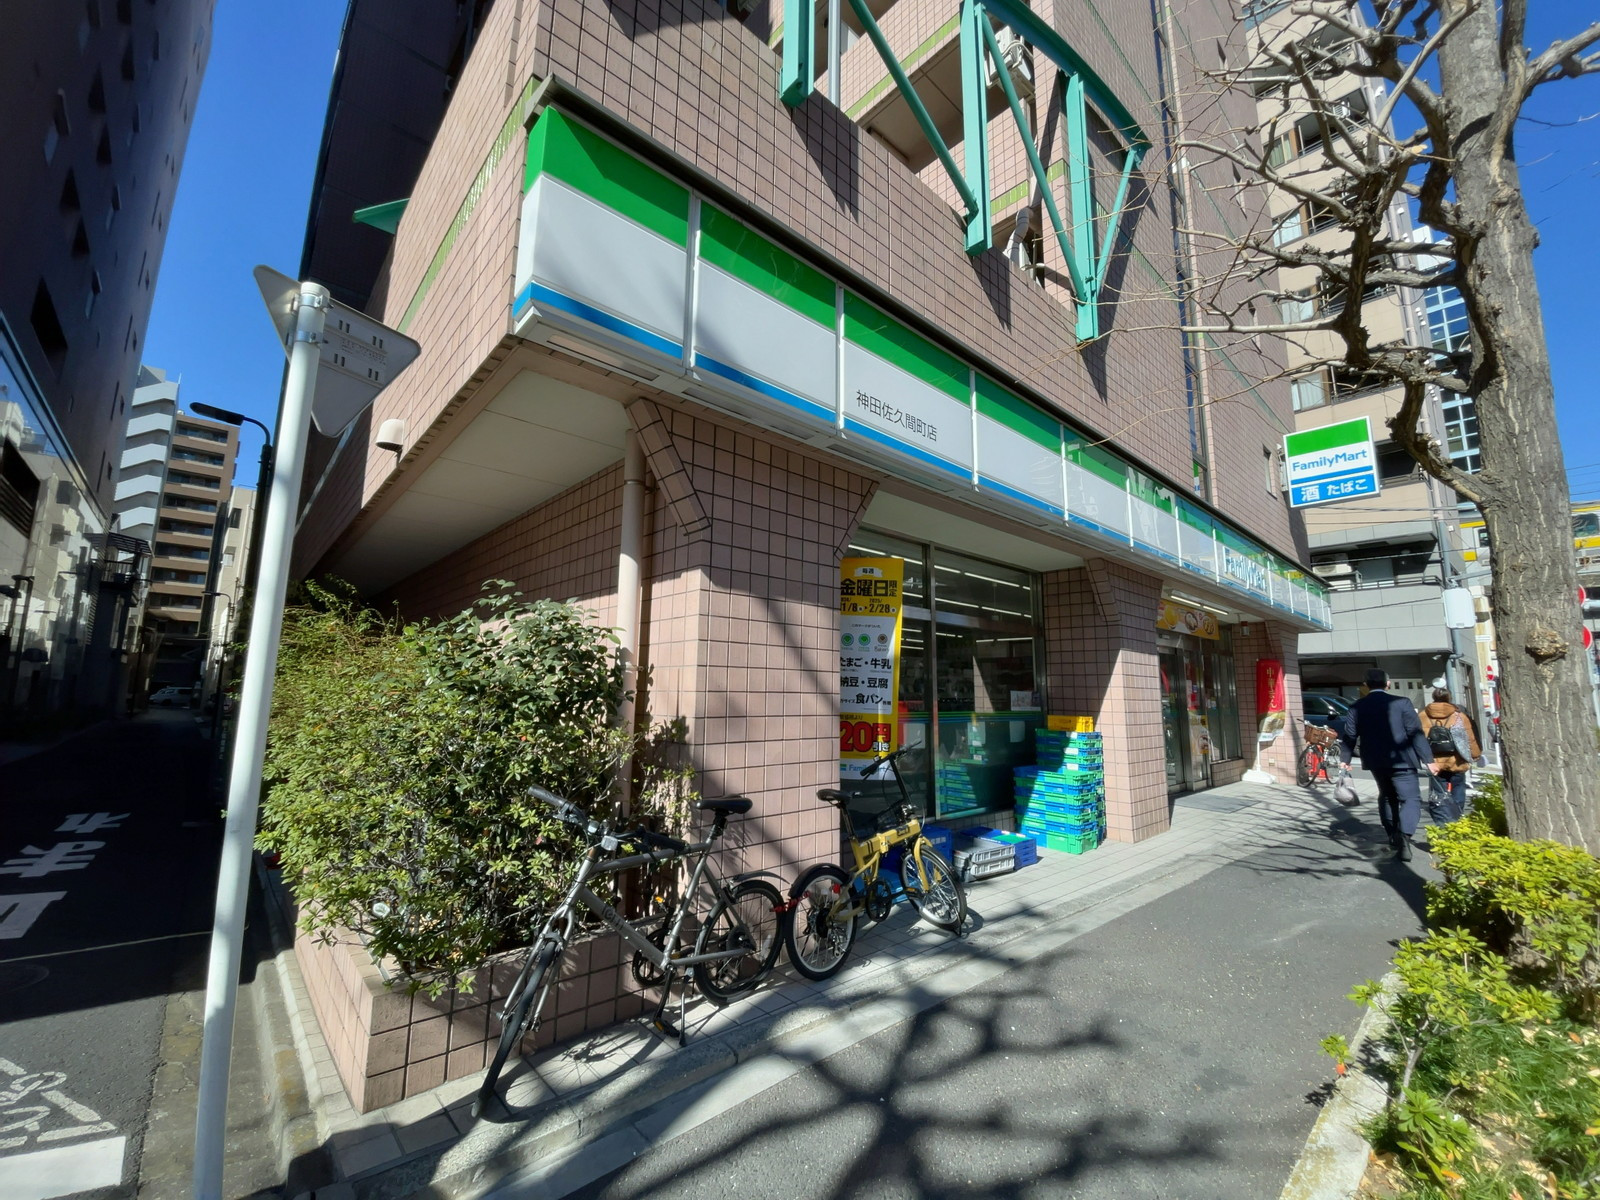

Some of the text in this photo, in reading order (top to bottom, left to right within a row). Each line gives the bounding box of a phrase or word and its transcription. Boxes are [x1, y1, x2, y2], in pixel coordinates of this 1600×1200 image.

[856, 389, 937, 442] 神田佐久間町店
[1292, 449, 1368, 472] FamilyMart
[1300, 479, 1369, 502] 酒 たばこ
